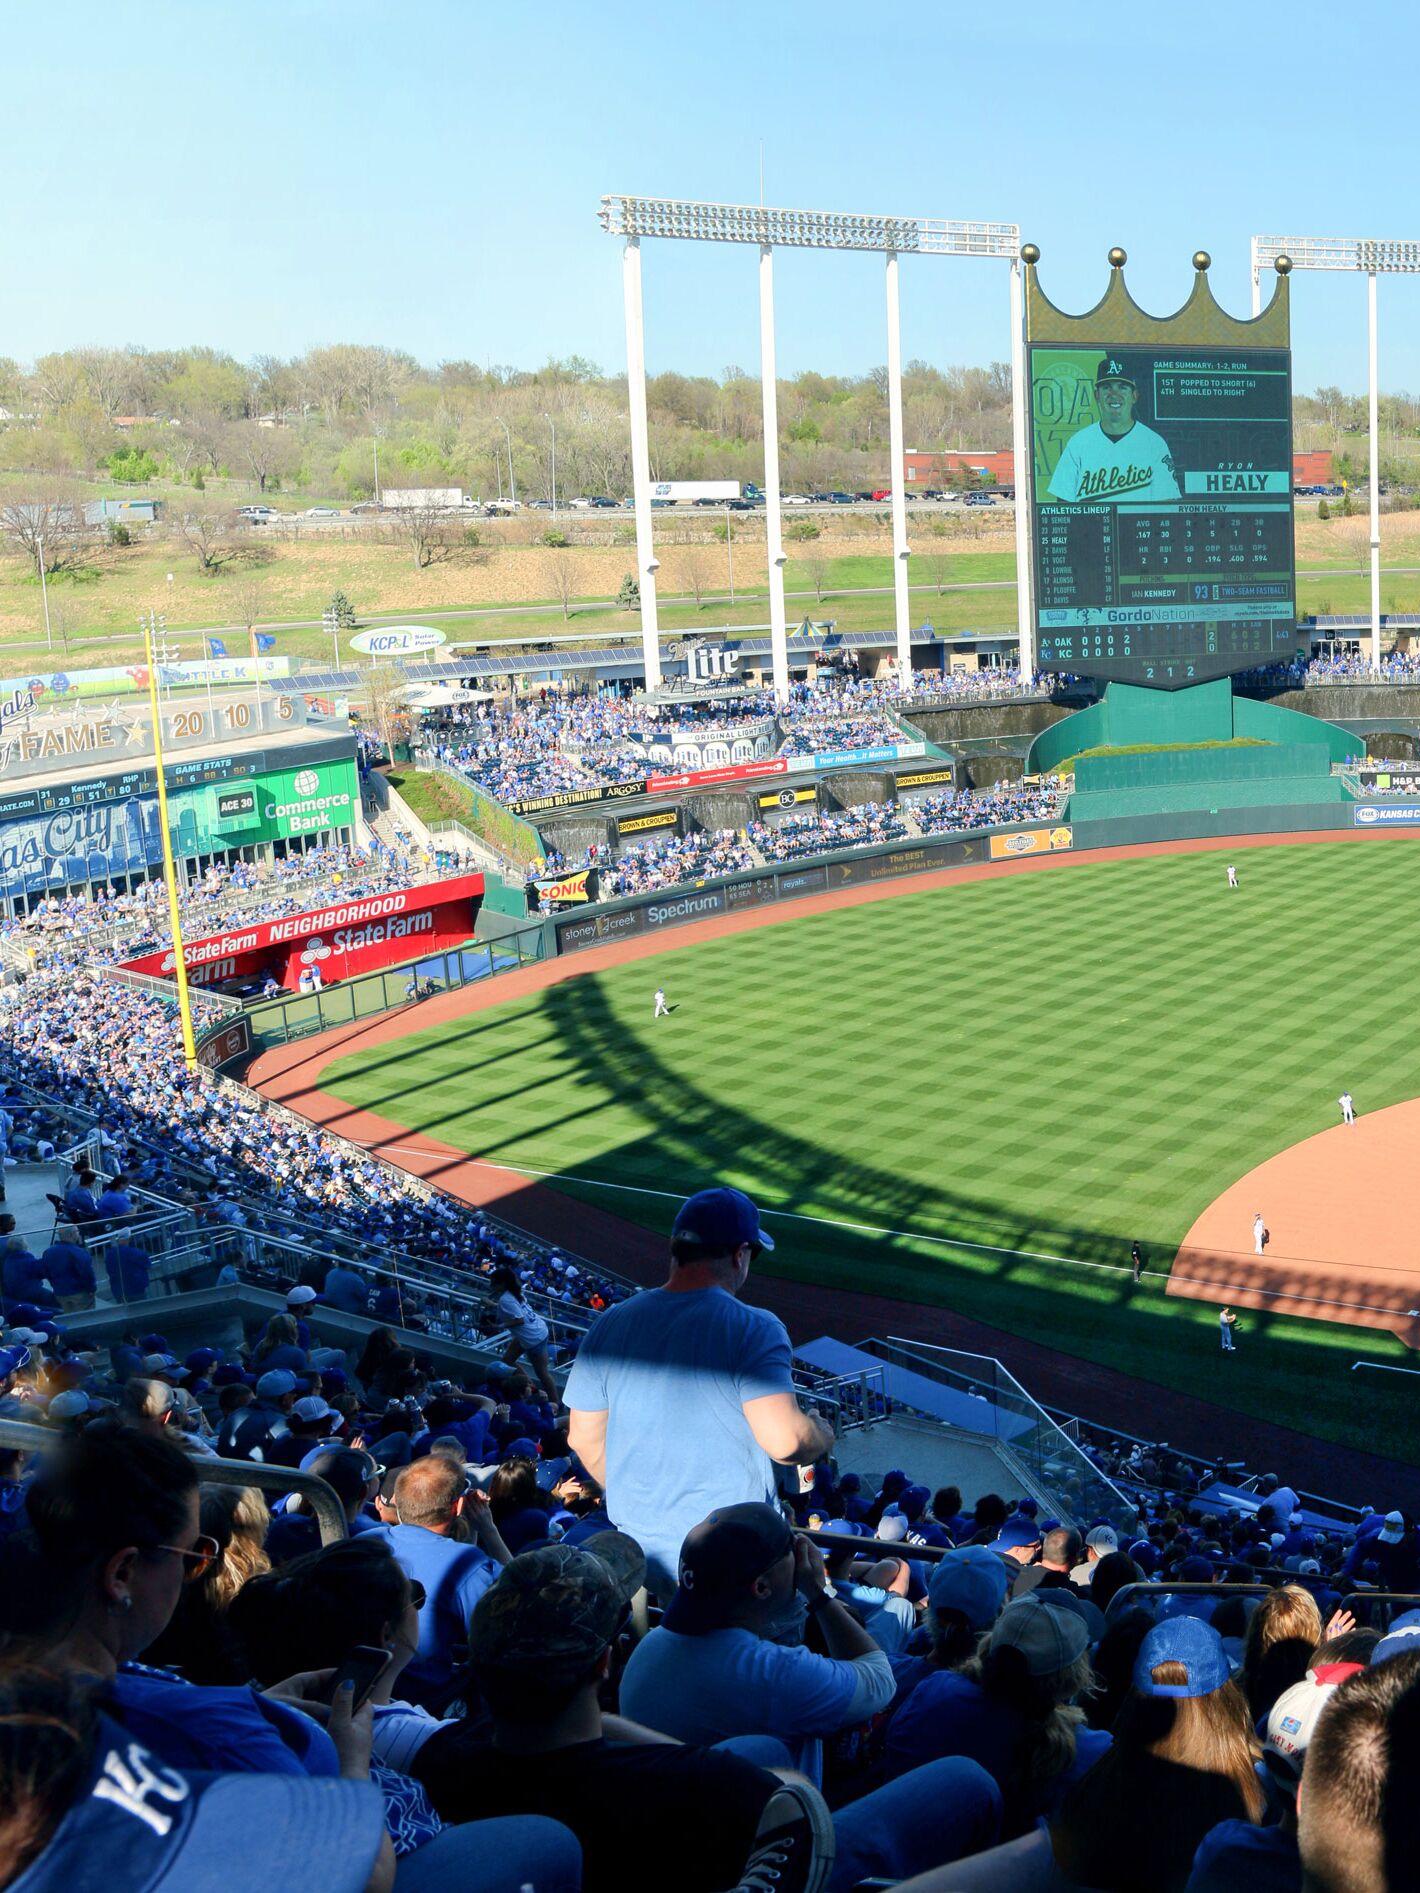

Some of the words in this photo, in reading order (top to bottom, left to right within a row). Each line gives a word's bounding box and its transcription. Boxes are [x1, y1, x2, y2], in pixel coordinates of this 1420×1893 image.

[1077, 464, 1152, 497] Athletics
[1206, 474, 1268, 492] HEALY
[1084, 506, 1110, 514] LINEUP
[1144, 589, 1176, 598] KENNEDY
[1194, 585, 1208, 600] 93
[1256, 586, 1284, 594] FASTBALL
[1055, 637, 1072, 646] OAK
[1082, 636, 1088, 646] 0
[1094, 636, 1100, 645] 0
[1108, 636, 1114, 644] 0
[1124, 634, 1130, 644] 2
[1209, 632, 1214, 640] 2
[1059, 650, 1072, 658] KC
[1082, 648, 1088, 657] 0
[1095, 648, 1101, 656] 0
[1108, 648, 1114, 656] 0
[1124, 647, 1130, 656] 0
[1209, 643, 1215, 652] 0
[686, 648, 738, 685] Lite
[1146, 668, 1154, 678] 2
[1167, 667, 1172, 678] 1
[1188, 666, 1194, 676] 2
[696, 688, 732, 697] FOUNTAIN
[732, 686, 746, 694] BAR
[225, 703, 250, 728] 10
[278, 696, 292, 721] 5
[173, 711, 204, 738] 20
[20, 720, 116, 761] FAME
[694, 732, 734, 742] ORIGINAL
[738, 728, 758, 737] LIGHT
[819, 756, 833, 765] Your
[868, 750, 894, 758] Matters
[175, 764, 202, 776] GAME
[204, 759, 232, 770] STATS
[190, 775, 196, 784] 6
[250, 765, 256, 774] 3
[71, 781, 107, 794] Kennedy
[122, 774, 139, 784] RHP
[896, 776, 916, 786] BROWN
[40, 790, 50, 799] 31
[58, 796, 70, 806] 29
[88, 790, 100, 800] 51
[119, 784, 131, 794] 80
[606, 783, 642, 797] ARGOSY
[221, 800, 240, 812] ACE
[240, 797, 252, 809] 30
[264, 792, 350, 820] Commerce
[522, 798, 554, 812] WINNING
[555, 789, 602, 807] DESTINATION!
[781, 794, 794, 804] BC
[290, 811, 330, 832] Bank
[1378, 810, 1412, 820] KANSAS
[44, 805, 114, 860] City
[619, 820, 640, 832] BROWN
[889, 854, 904, 863] The
[904, 850, 924, 862] BEST
[871, 864, 907, 878] Unlimited
[909, 861, 928, 873] Plan
[540, 879, 586, 900] SONIC
[270, 895, 406, 942] NEIGHBORHOOD
[648, 896, 718, 924] Spectrum
[566, 926, 596, 940] stoney
[610, 912, 636, 928] creek
